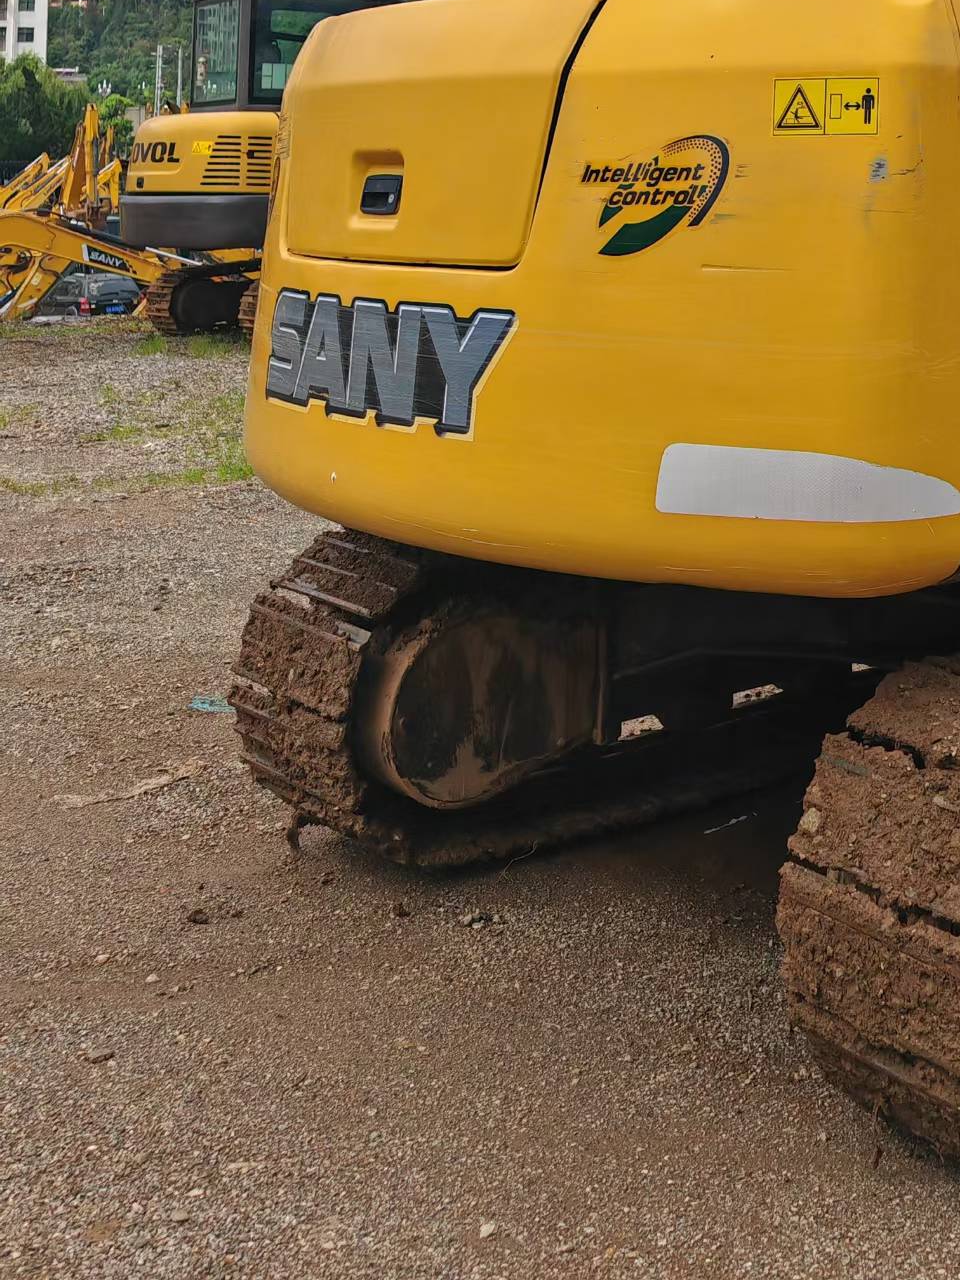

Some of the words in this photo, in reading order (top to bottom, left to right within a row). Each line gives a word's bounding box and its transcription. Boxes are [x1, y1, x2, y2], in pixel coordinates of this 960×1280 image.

[132, 142, 180, 163] OVOL
[581, 156, 705, 187] Intelligent
[608, 184, 697, 206] control
[89, 250, 123, 267] SANY
[266, 287, 516, 435] SANY
